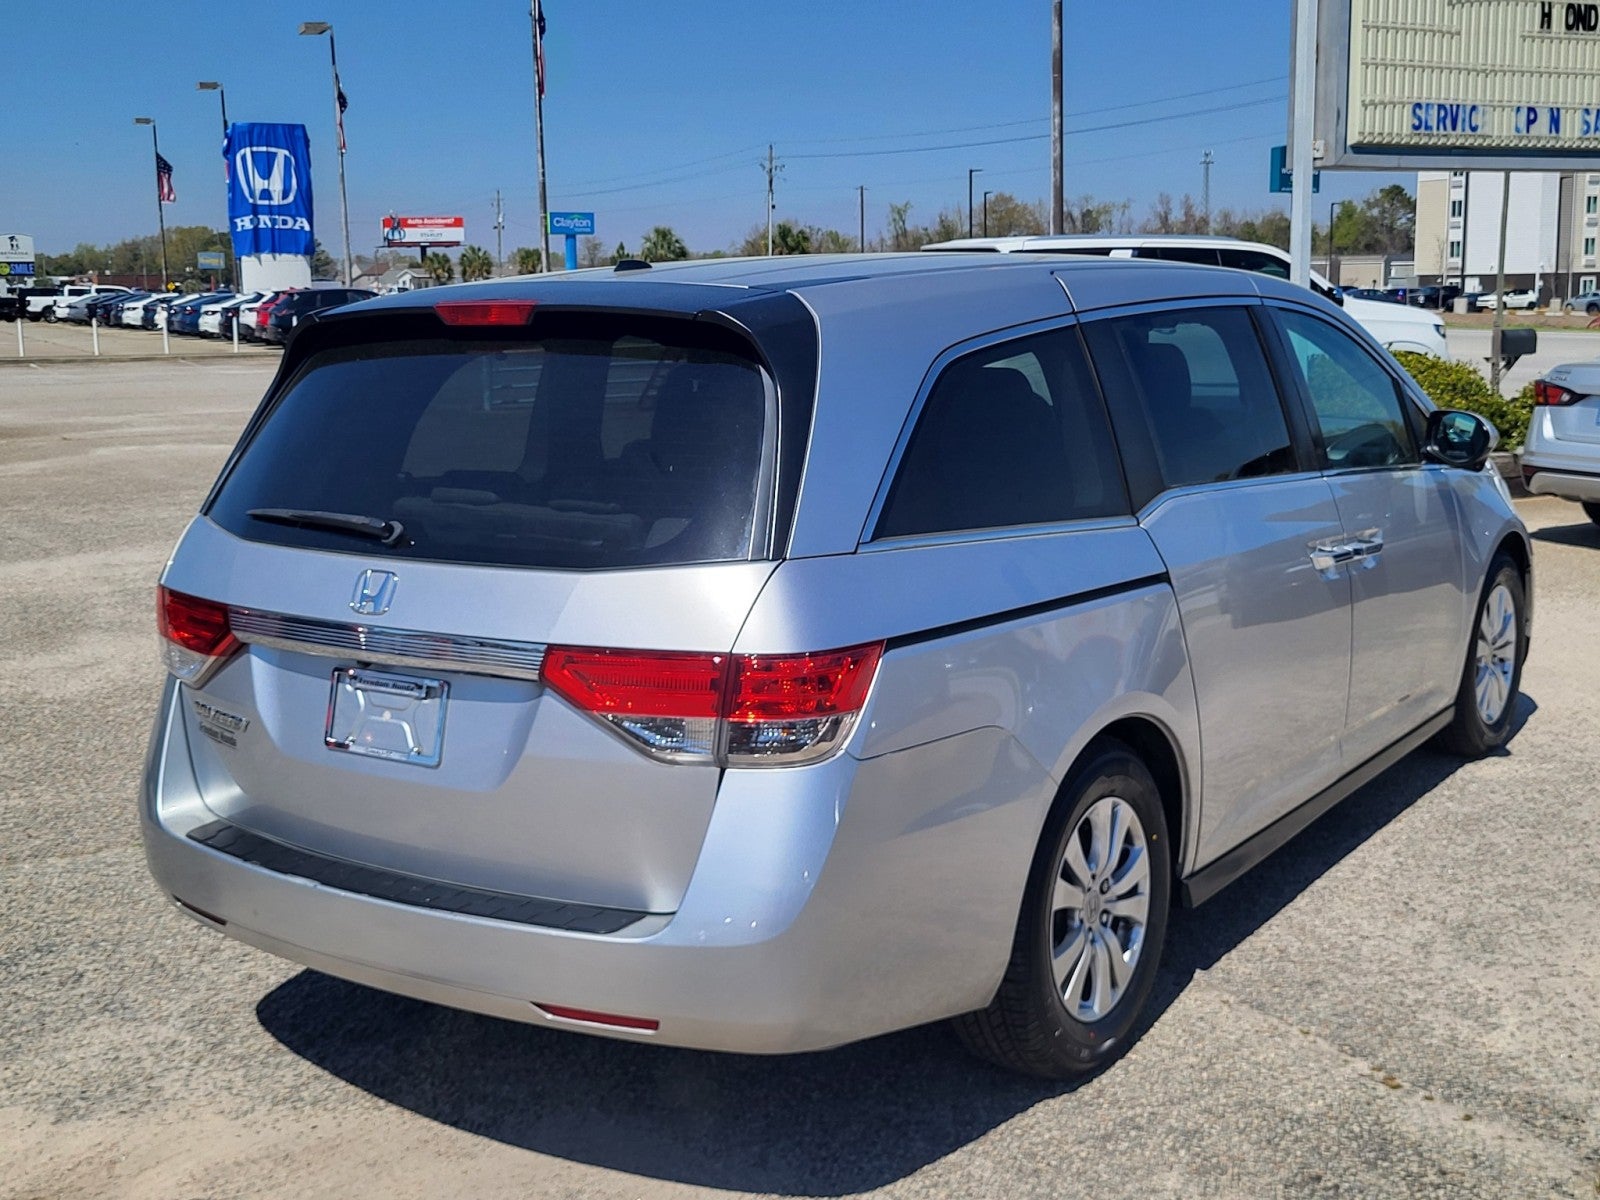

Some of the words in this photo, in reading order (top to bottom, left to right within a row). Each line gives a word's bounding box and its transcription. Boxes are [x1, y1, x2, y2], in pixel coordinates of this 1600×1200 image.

[1411, 102, 1485, 133] SERVIC
[553, 217, 591, 229] Clayton
[10, 263, 35, 275] SMILE
